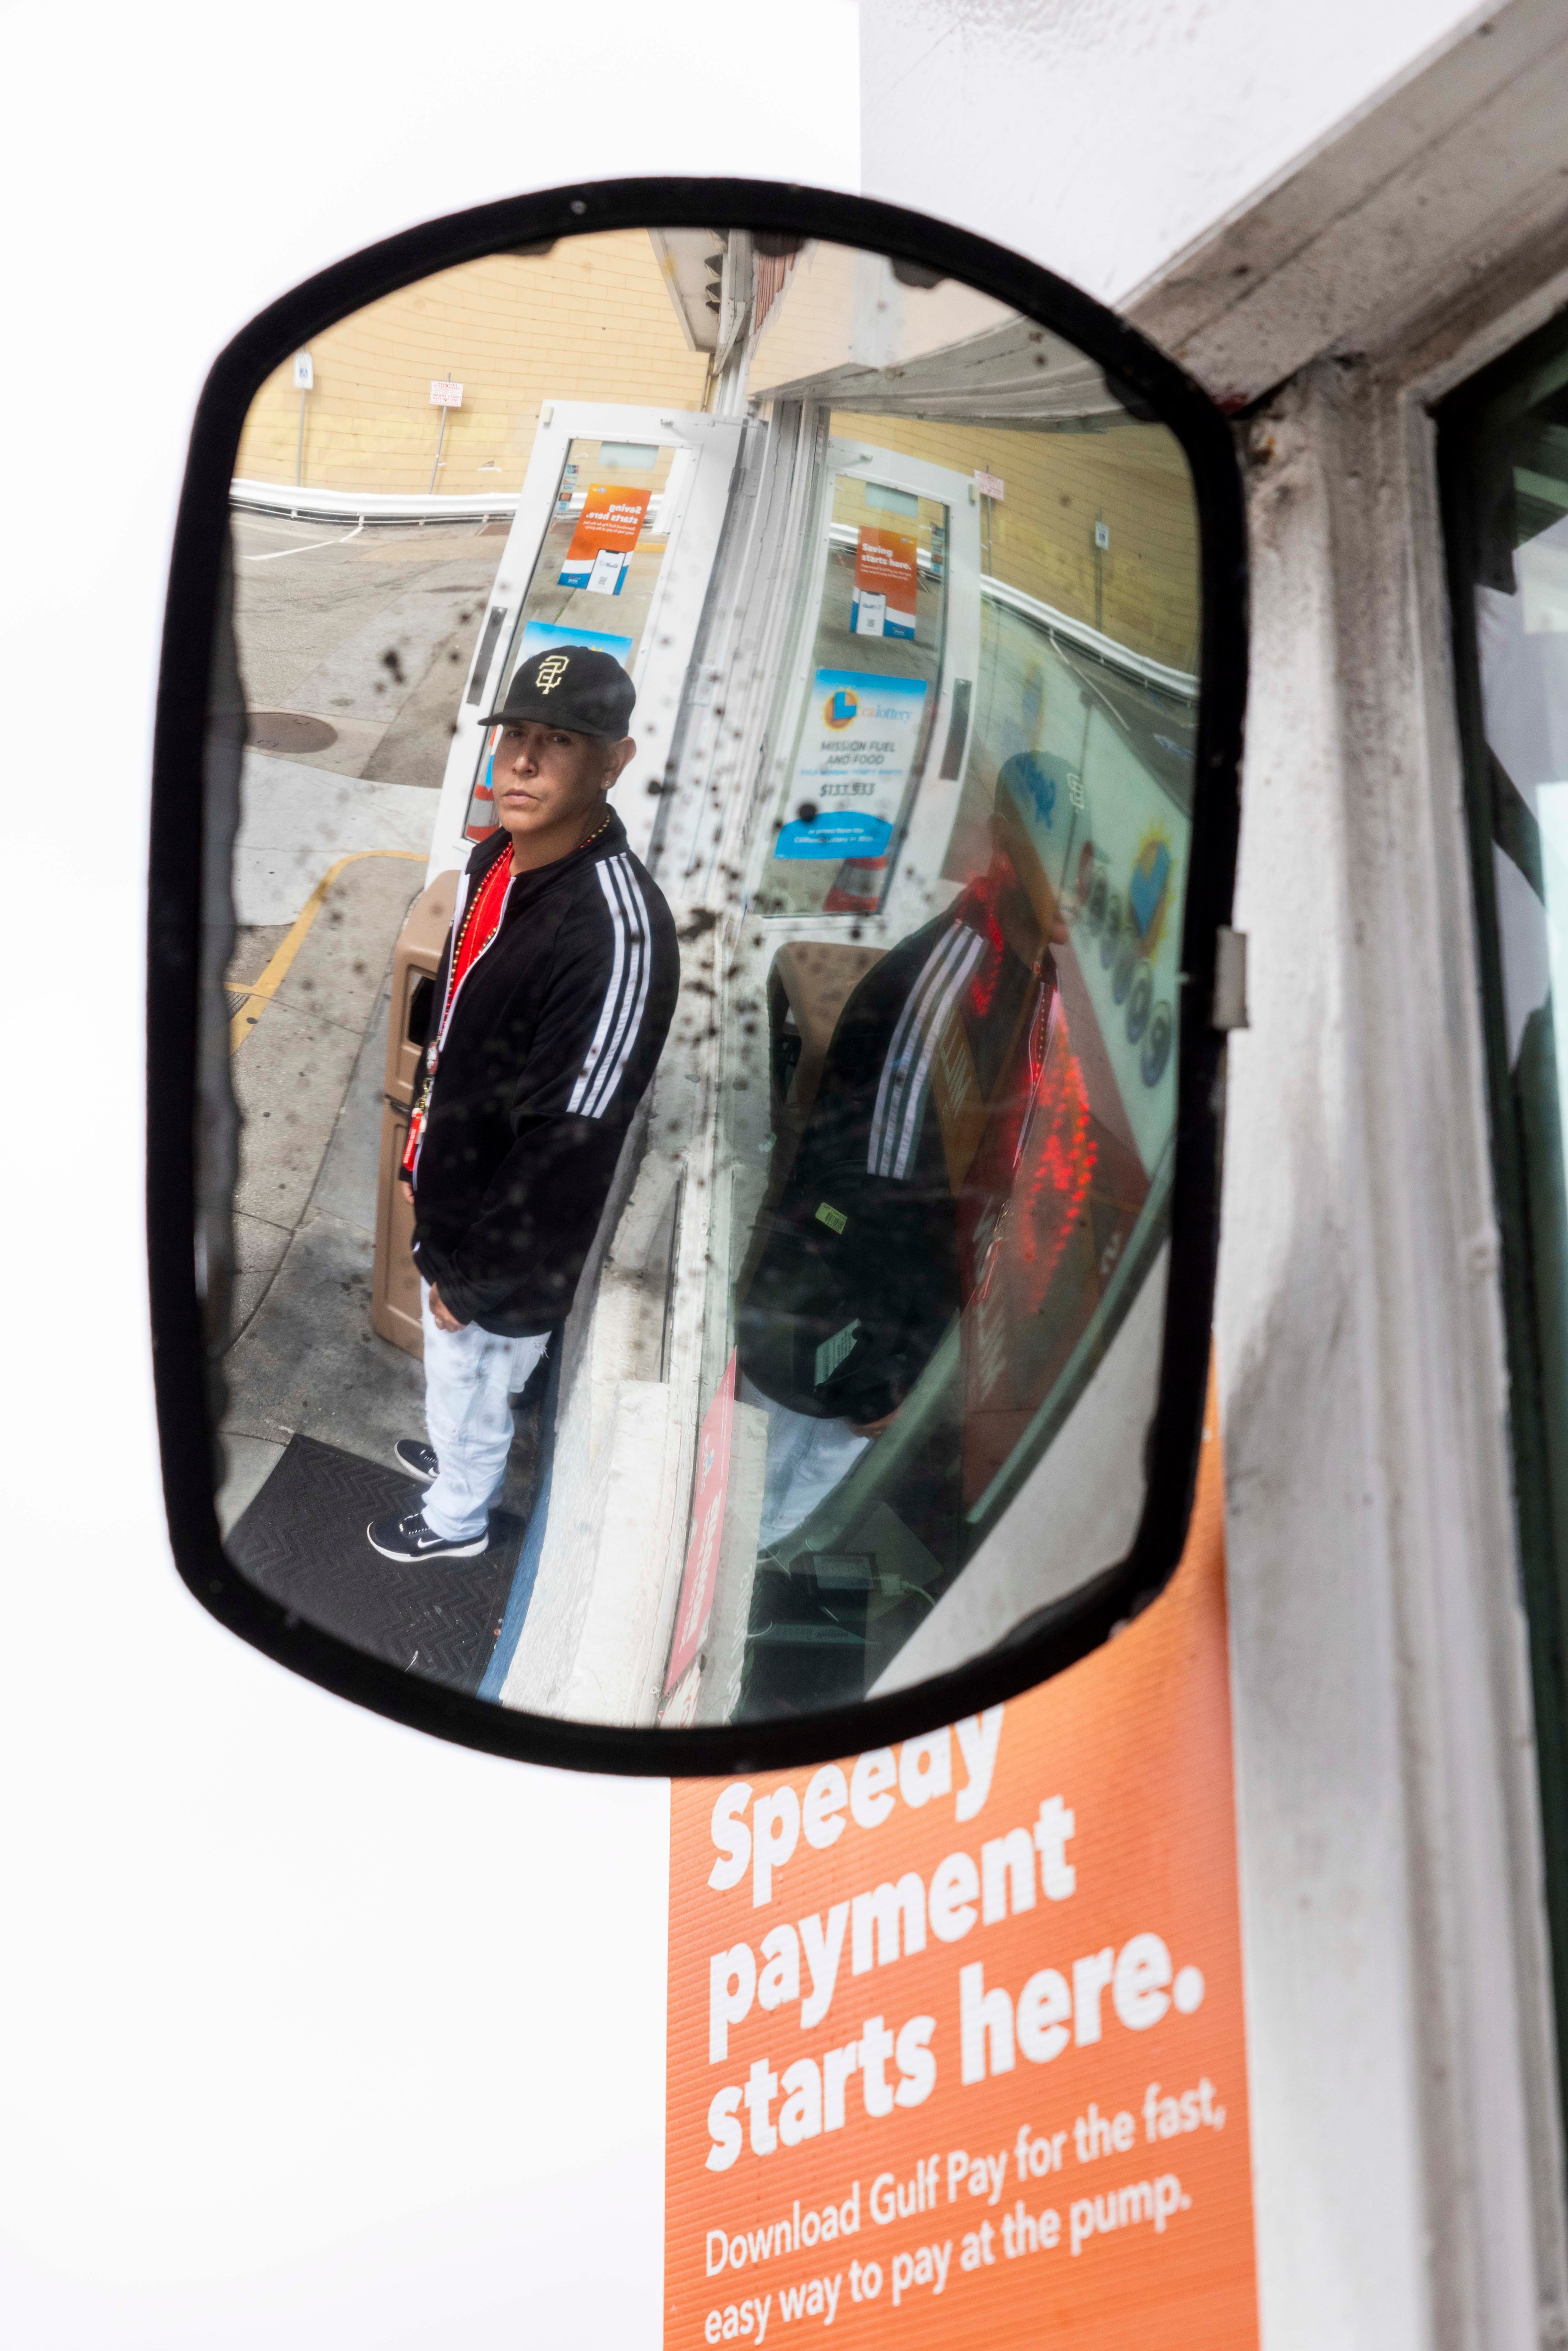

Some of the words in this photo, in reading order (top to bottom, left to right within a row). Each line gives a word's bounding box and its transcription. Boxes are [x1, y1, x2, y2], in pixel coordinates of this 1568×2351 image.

[861, 554, 887, 565] starts
[889, 558, 912, 571] here.
[862, 543, 893, 558] Saving
[820, 741, 866, 752] MISSION
[869, 741, 895, 752] FUEL
[827, 754, 851, 765] AND
[853, 754, 885, 765] FOOD
[707, 1704, 1004, 1909] Speedy
[709, 1794, 1076, 2065] payment
[705, 2015, 937, 2172] starts
[960, 1932, 1205, 2084] here.
[705, 2294, 772, 2346] easy
[779, 2273, 842, 2326] way
[849, 2259, 883, 2303] to
[892, 2239, 953, 2307] pay
[960, 2219, 996, 2271] at
[1001, 2199, 1061, 2259] the
[1070, 2173, 1192, 2257] pump.
[706, 2180, 860, 2277] Download
[870, 2153, 941, 2226] Gulf
[947, 2149, 1008, 2207] Pay
[1014, 2124, 1067, 2182] for
[1073, 2102, 1136, 2164] the
[1142, 2077, 1226, 2144] fast,
